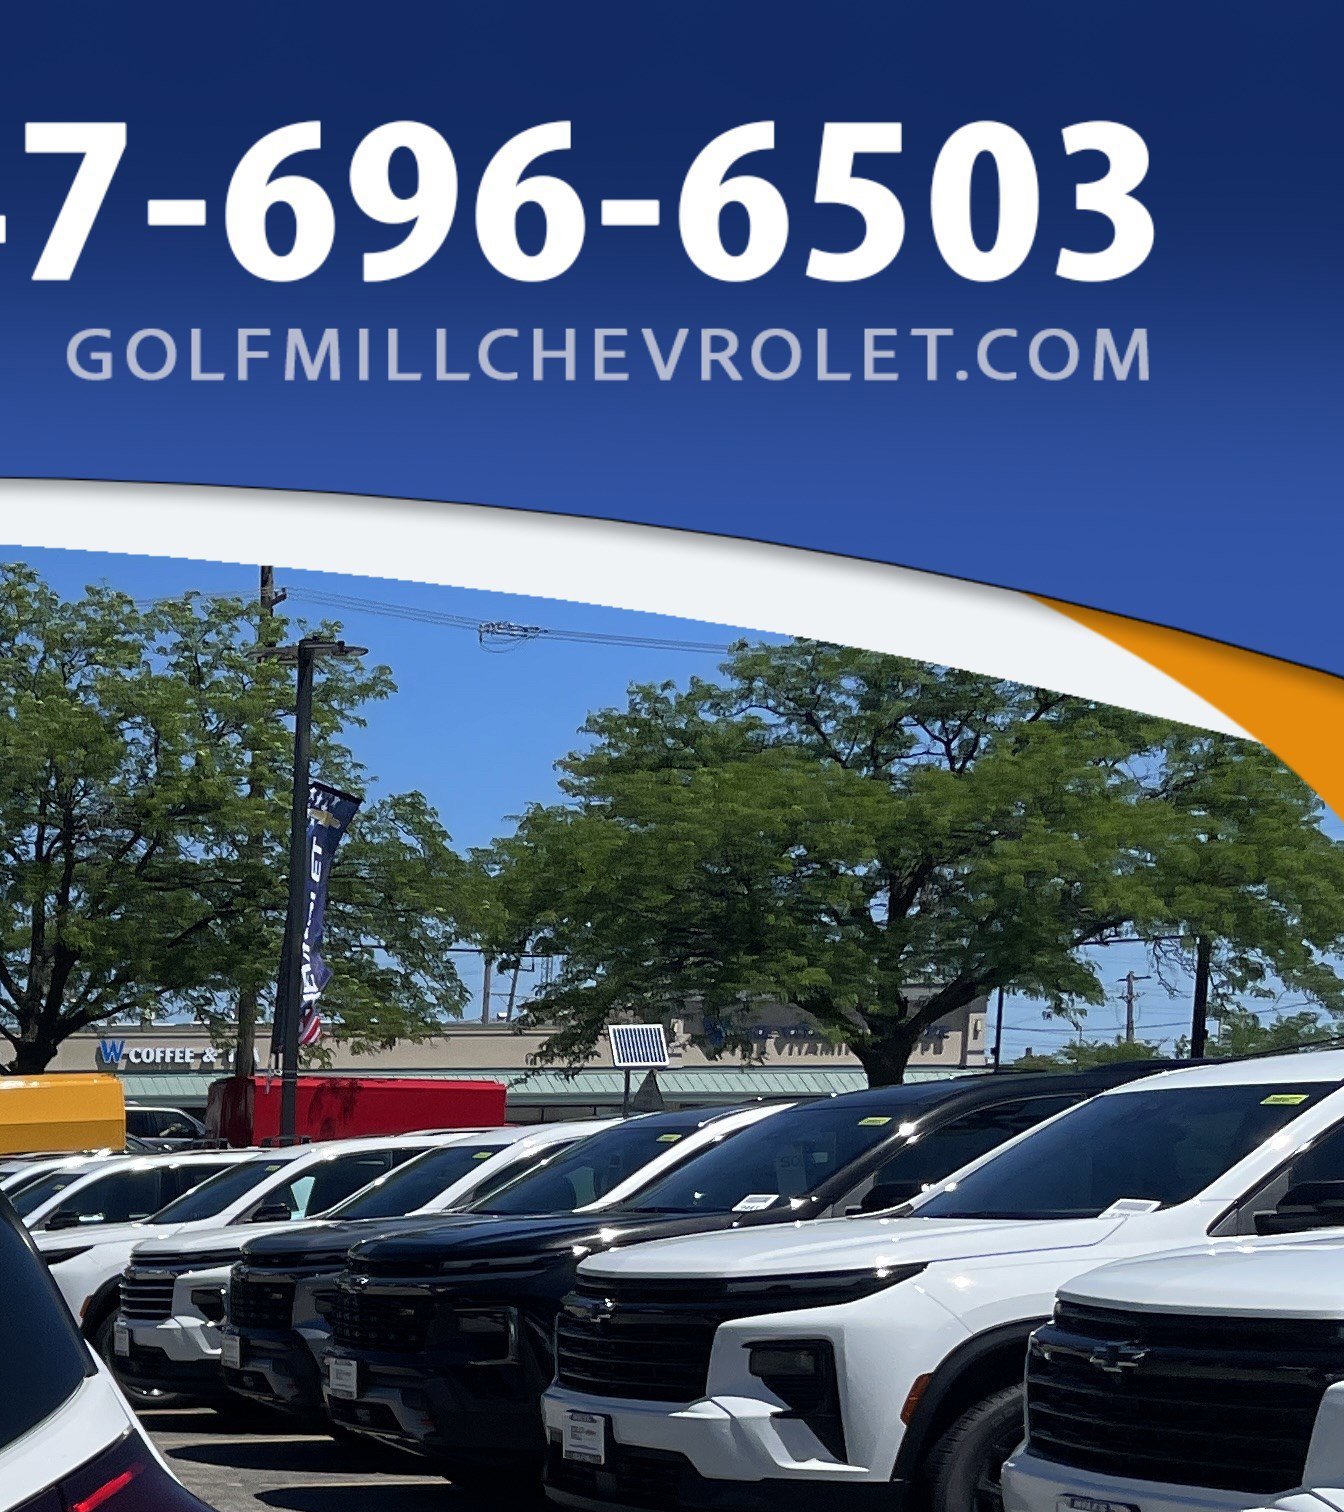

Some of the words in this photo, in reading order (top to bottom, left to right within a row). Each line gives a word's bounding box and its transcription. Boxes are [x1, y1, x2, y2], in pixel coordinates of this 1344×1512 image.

[100, 1040, 125, 1064] W
[128, 1048, 195, 1063] COFFEE
[202, 1047, 219, 1063] &
